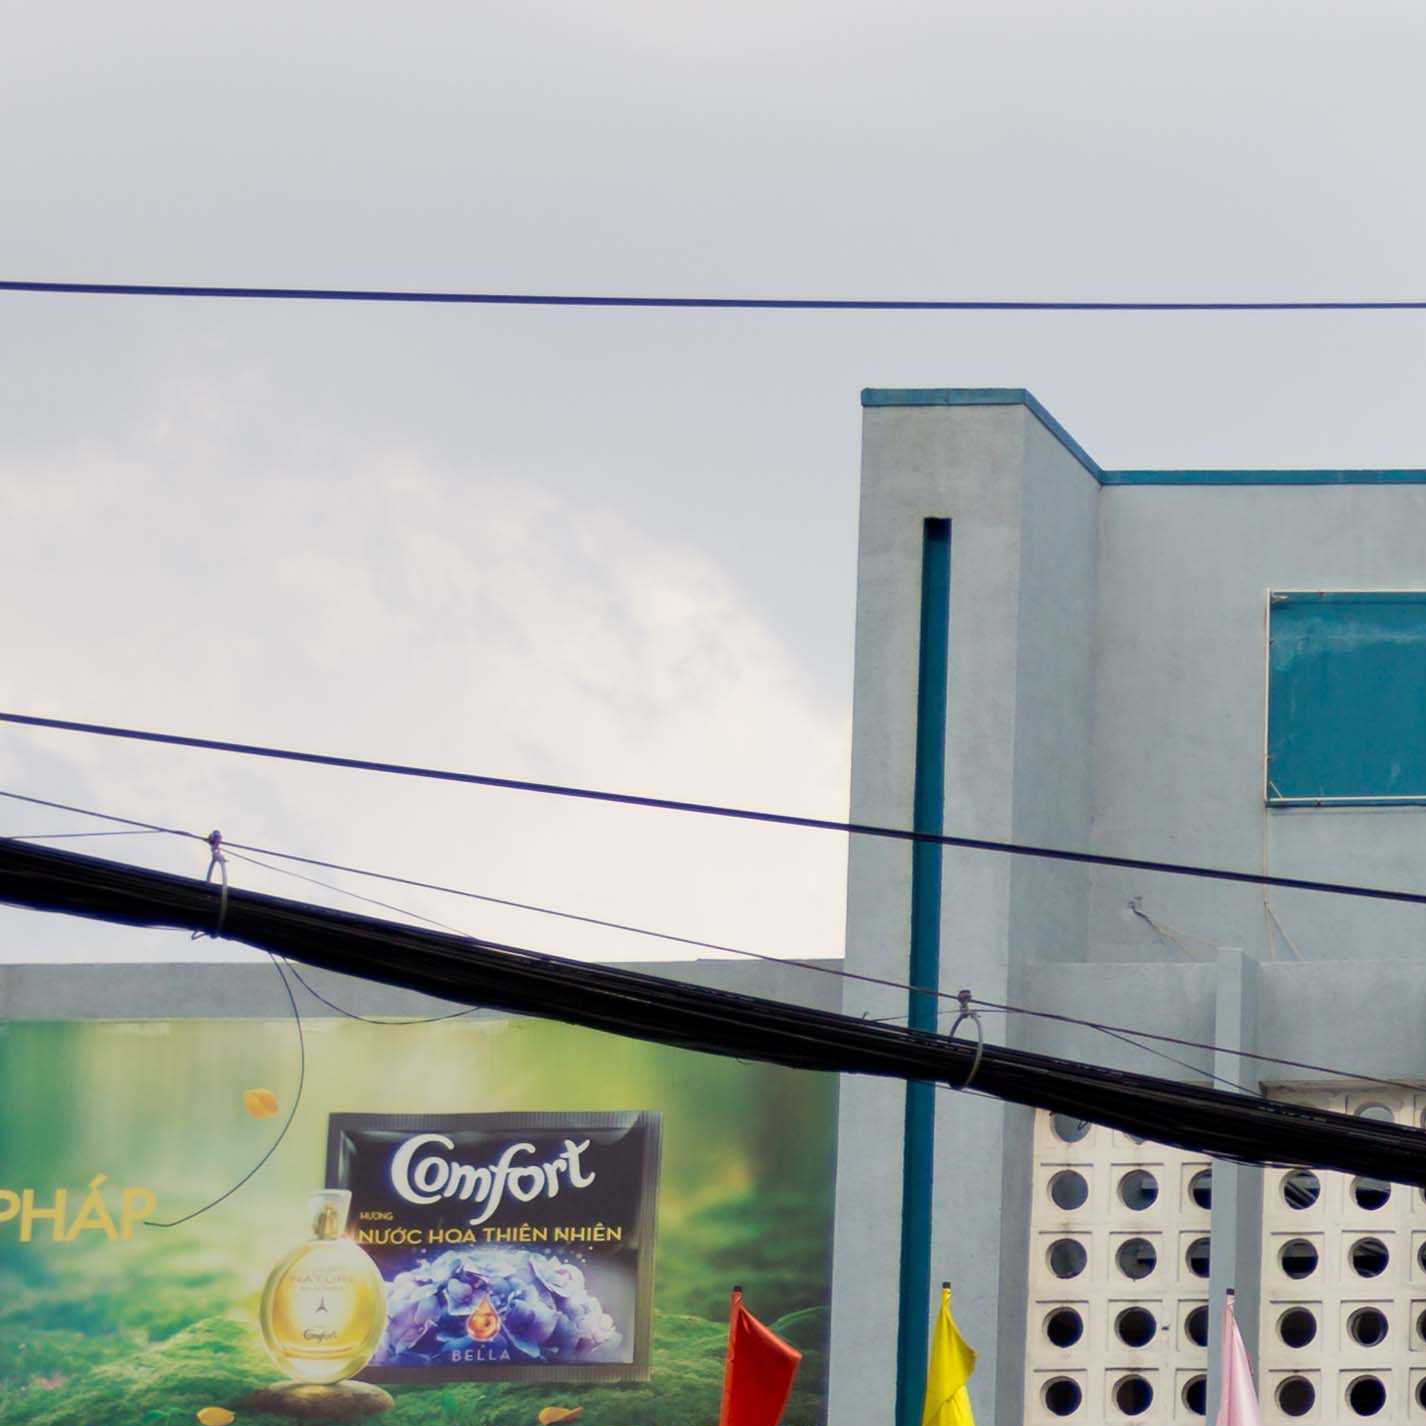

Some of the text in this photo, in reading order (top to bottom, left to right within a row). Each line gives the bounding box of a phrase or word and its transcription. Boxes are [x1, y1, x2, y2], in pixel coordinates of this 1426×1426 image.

[391, 1133, 596, 1225] Comfort
[358, 1221, 623, 1245] NƯỚC HOA THIÊN NHIÊN
[452, 1348, 512, 1361] BELLA
